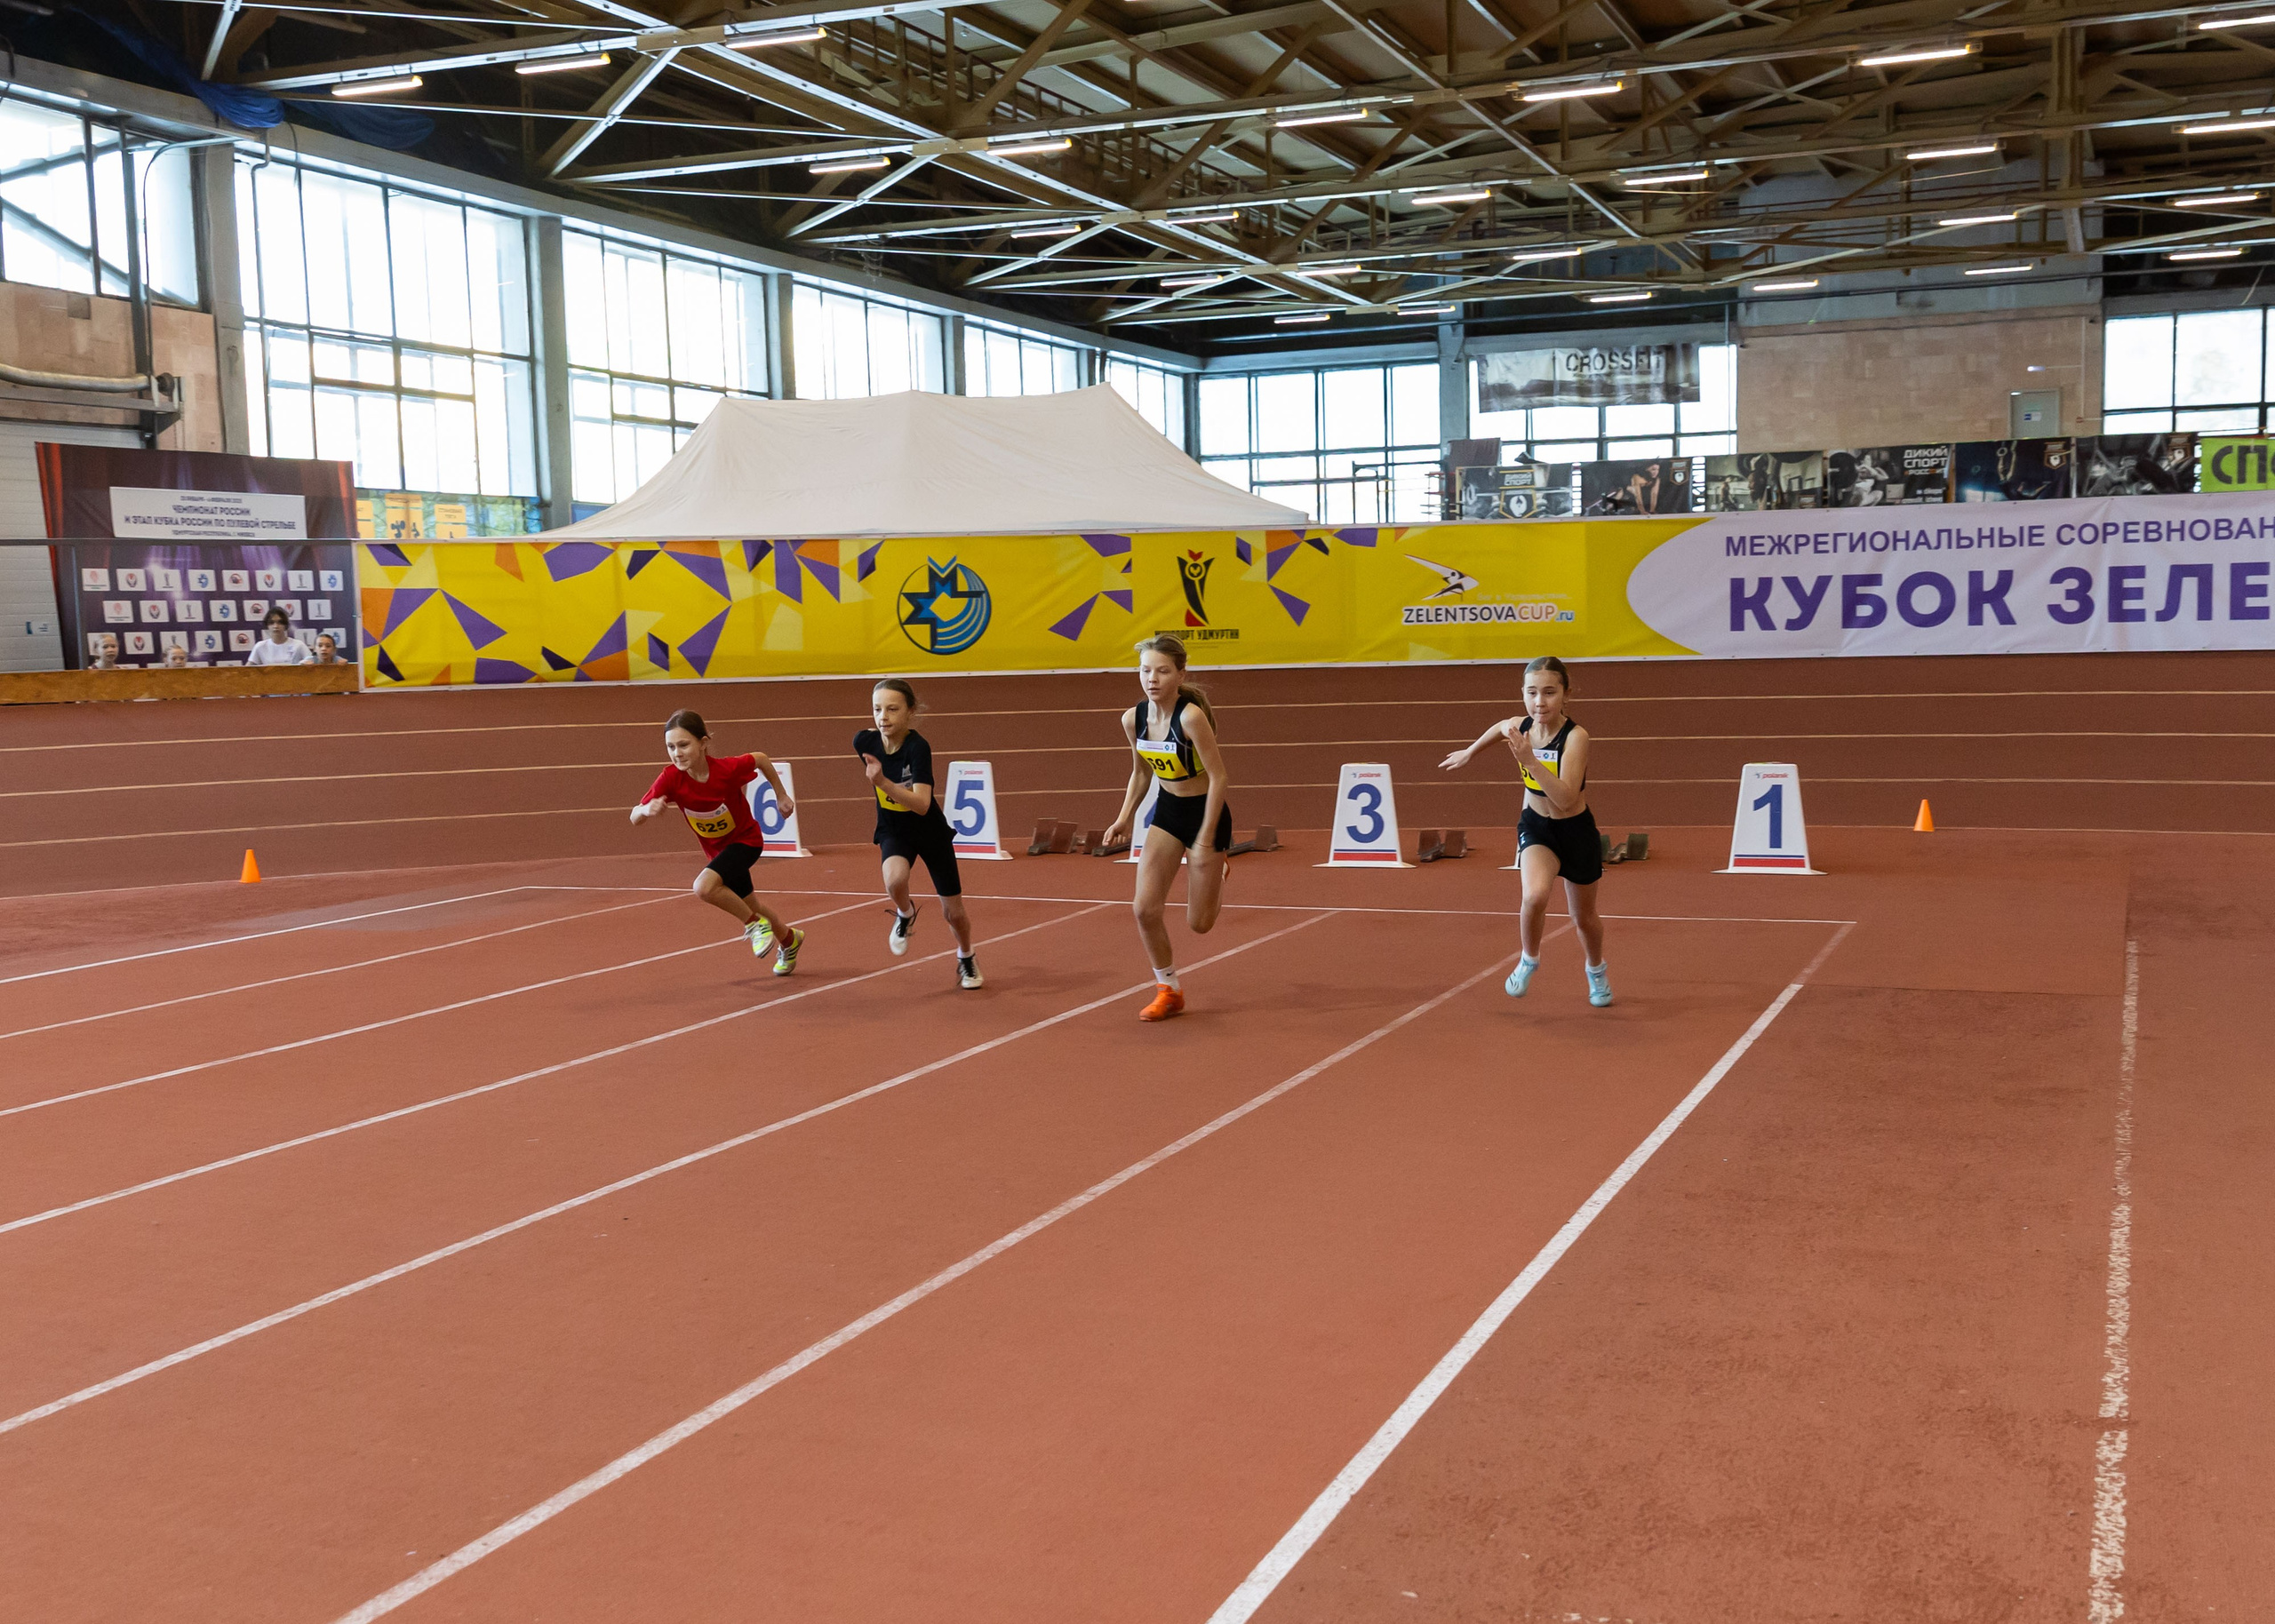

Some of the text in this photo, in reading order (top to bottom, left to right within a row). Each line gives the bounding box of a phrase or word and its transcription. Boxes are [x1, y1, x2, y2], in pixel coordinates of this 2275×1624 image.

[1566, 351, 1663, 371] CROSSFIT
[1903, 445, 1948, 458] ДИКИЙ
[1904, 458, 1947, 468] СПОРТ
[2212, 444, 2275, 485] СП
[180, 517, 212, 527] РОССИИ
[220, 506, 251, 516] РОССИИ
[1725, 524, 2046, 557] МЕЖРЕГИОНАЛЬНЫЕ
[1728, 561, 2271, 633] КУБОК ЗЕЛЕ
[754, 781, 786, 835] 6
[953, 780, 986, 836] 5
[1346, 784, 1385, 843] 3
[1753, 784, 1783, 848] 1
[696, 819, 728, 832] 625
